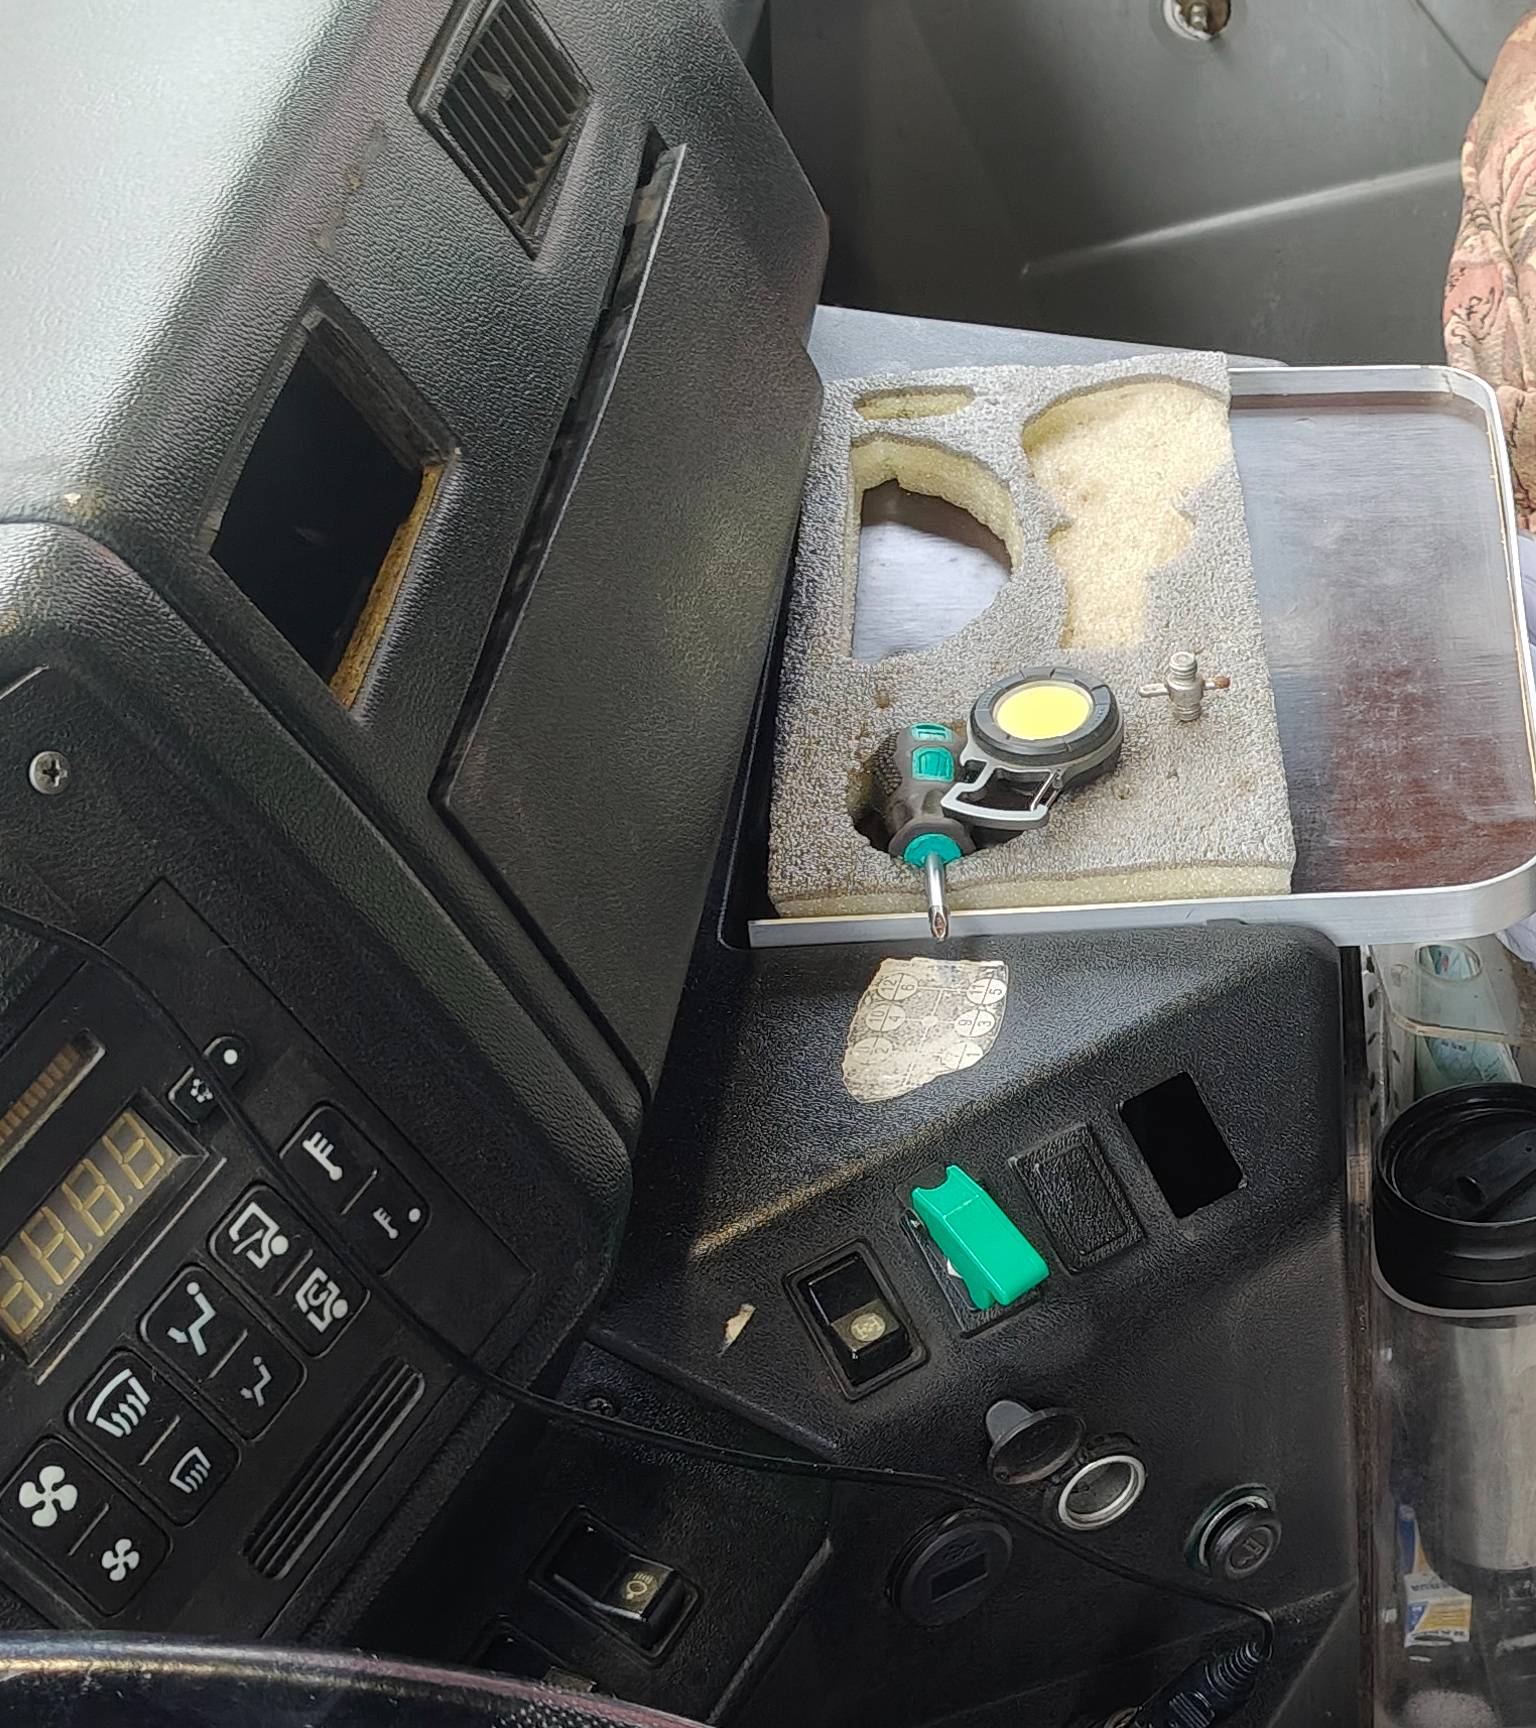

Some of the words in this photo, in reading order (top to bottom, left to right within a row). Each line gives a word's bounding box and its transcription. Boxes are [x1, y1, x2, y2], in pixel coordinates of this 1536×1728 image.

[881, 978, 898, 993] 12
[901, 984, 915, 992] 6
[970, 983, 985, 996] 11
[990, 987, 1003, 996] 5
[869, 1010, 885, 1023] 10
[958, 1019, 973, 1027] 9
[977, 1020, 992, 1028] 3
